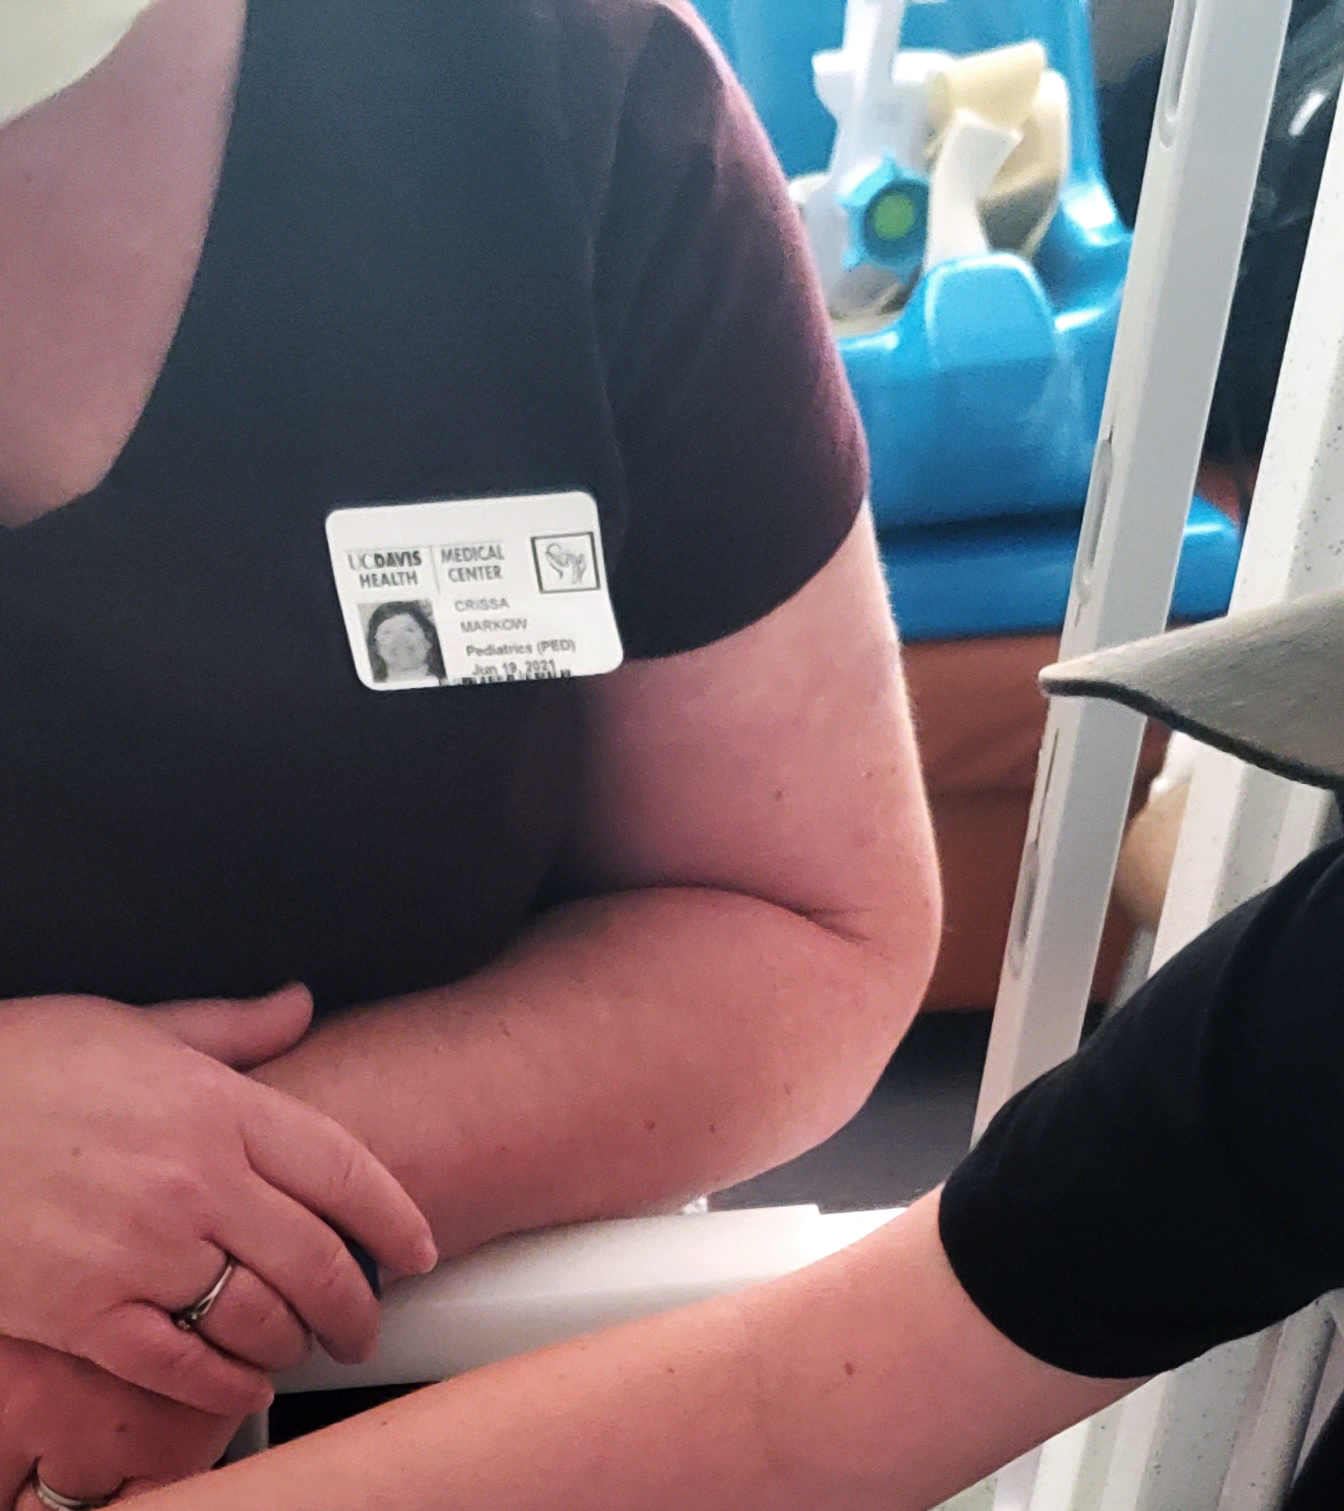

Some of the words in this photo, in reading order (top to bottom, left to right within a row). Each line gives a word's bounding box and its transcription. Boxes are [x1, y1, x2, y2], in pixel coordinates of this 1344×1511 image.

[441, 544, 505, 564] MEDICAL
[359, 570, 418, 589] HEALTH
[448, 565, 503, 583] CENTER
[454, 598, 510, 612] CRISSA
[460, 618, 527, 632] MARKOW
[466, 642, 533, 656] Pediatrics
[537, 639, 576, 655] (PED)
